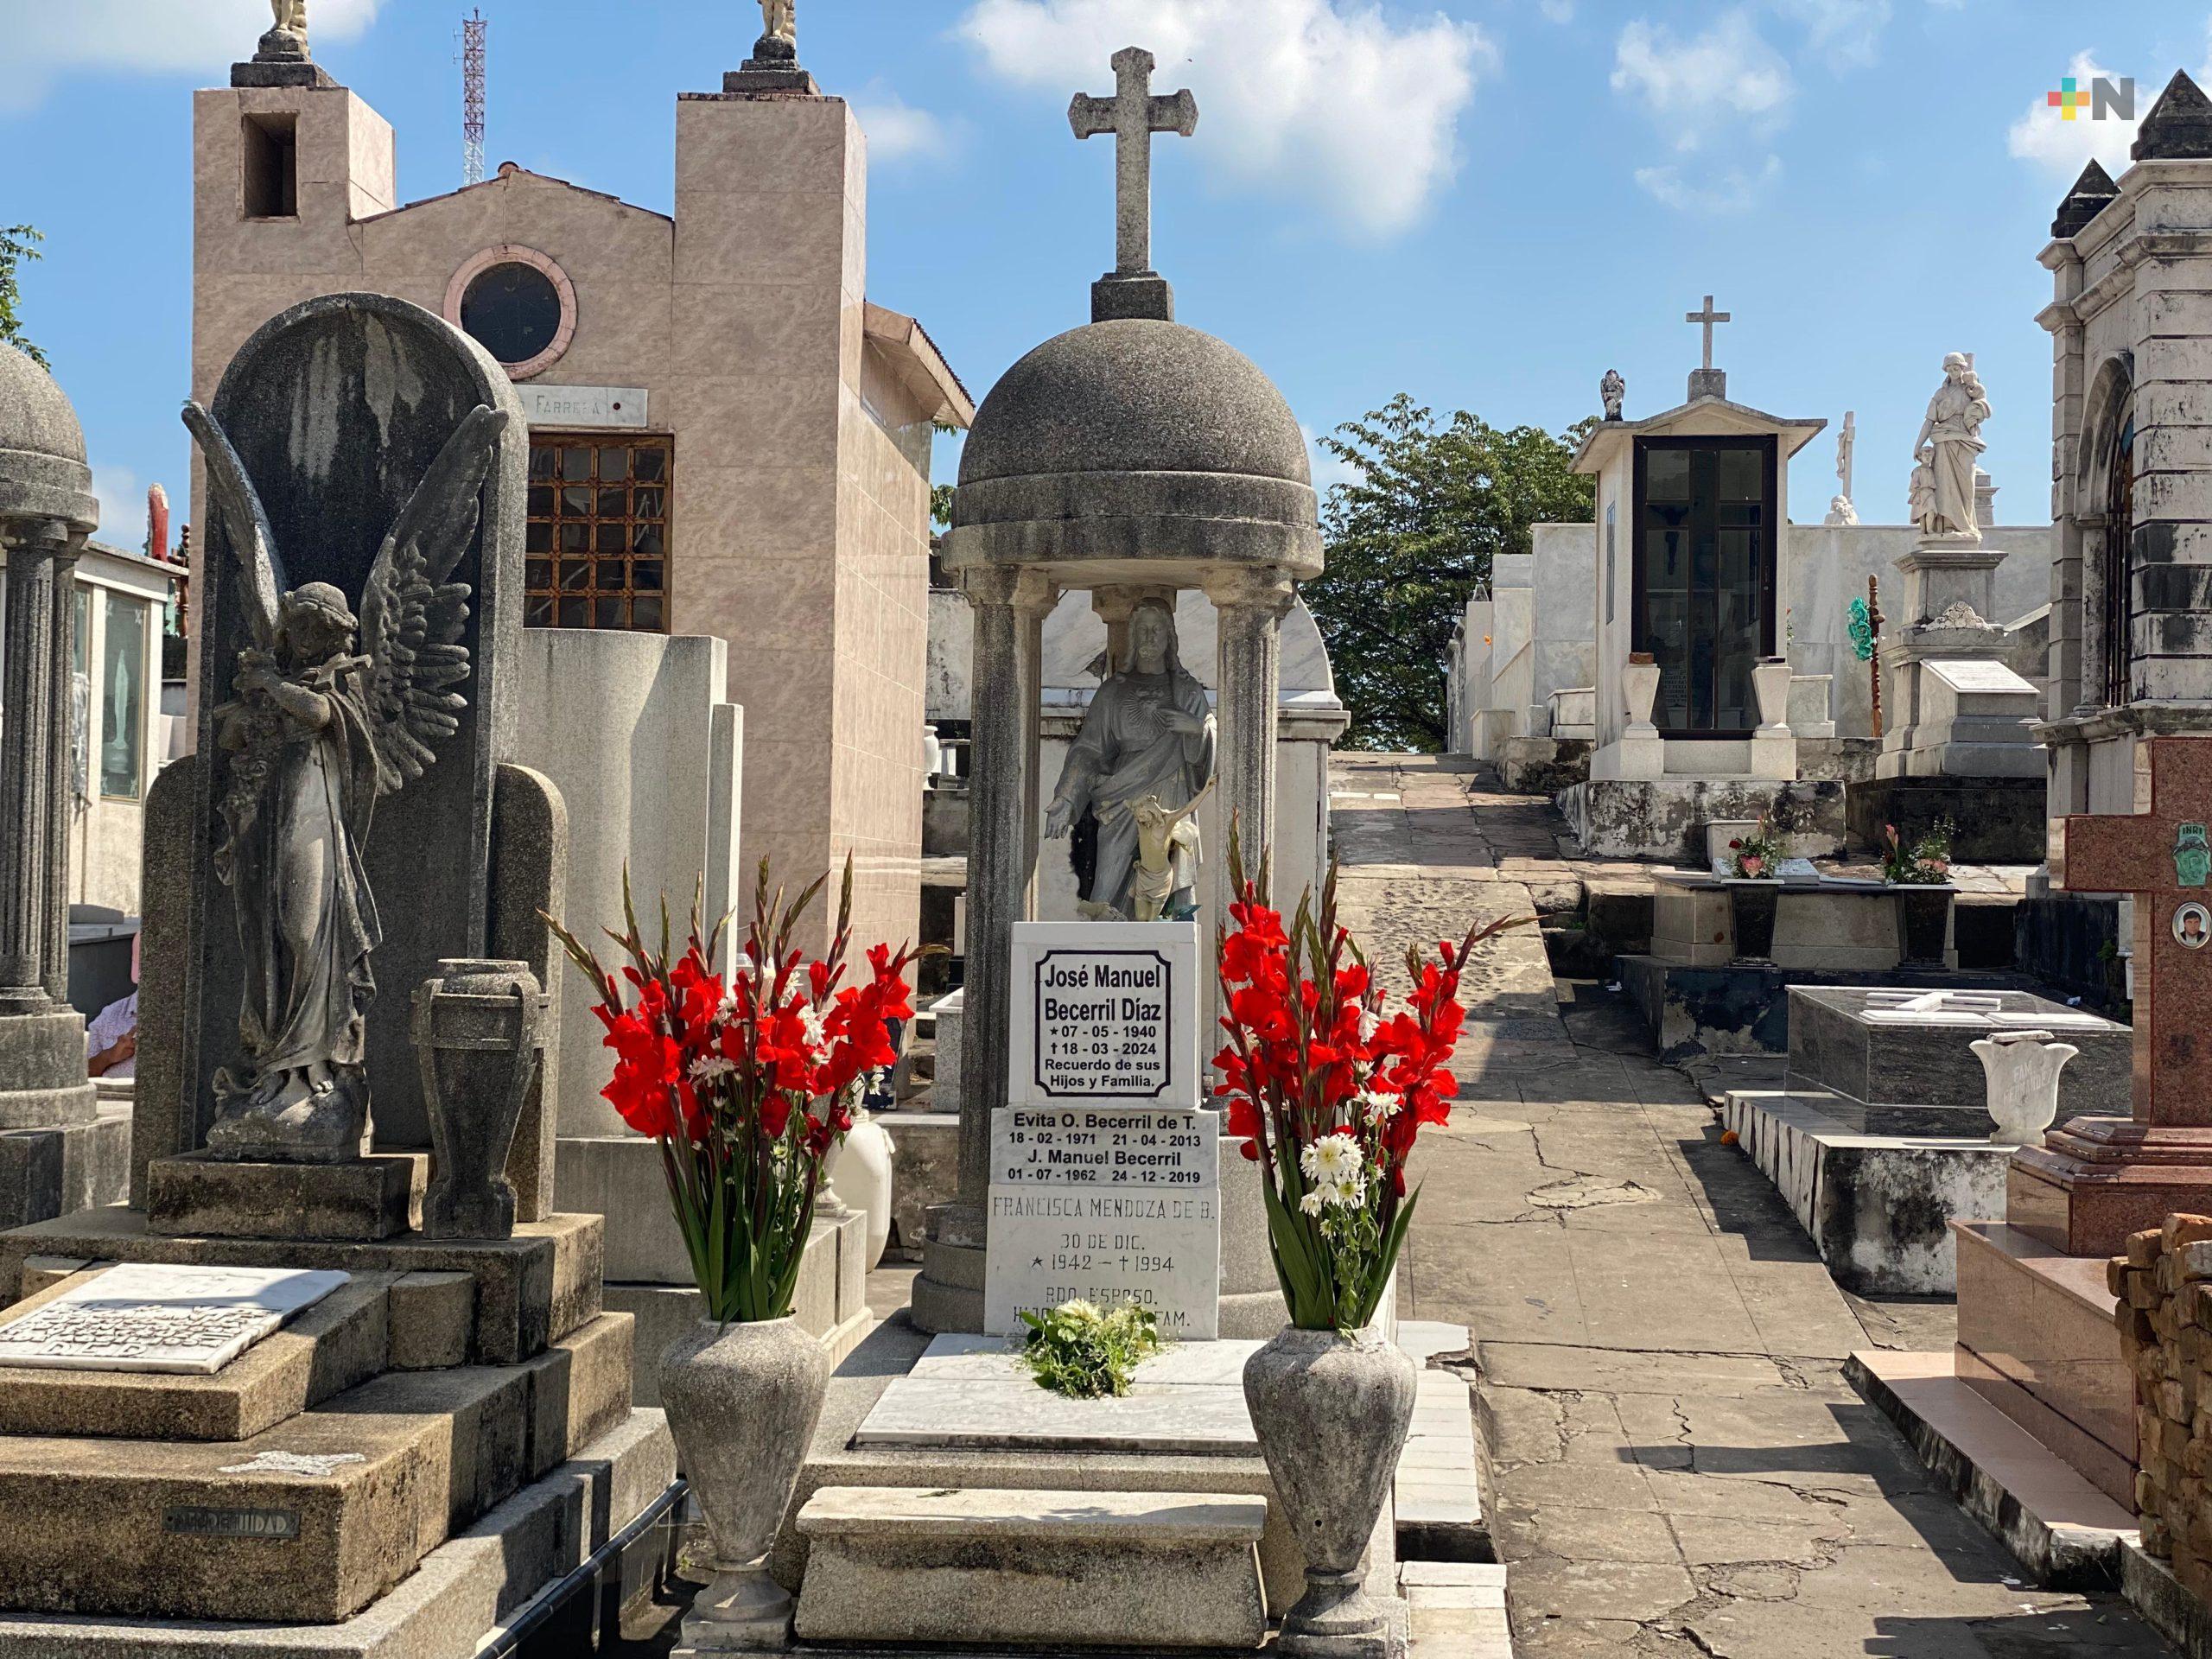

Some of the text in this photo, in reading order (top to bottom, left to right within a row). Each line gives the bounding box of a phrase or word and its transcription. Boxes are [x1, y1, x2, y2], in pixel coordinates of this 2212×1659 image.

[2183, 826, 2202, 835] INRI
[1044, 964, 1160, 988] José Manuel
[1045, 997, 1162, 1022] Becerril Díaz
[1061, 1025, 1078, 1038] 07
[1091, 1025, 1109, 1038] 05
[1122, 1025, 1157, 1039] 1940
[1061, 1042, 1078, 1055] 18
[1091, 1042, 1109, 1055] 03
[1122, 1042, 1157, 1055] 2024
[1045, 1058, 1160, 1071] Recuerdo de sus
[1050, 1075, 1155, 1090] Hijos y Familia.
[1014, 1112, 1197, 1131] Evita O. Becerril de T.
[1008, 1132, 1025, 1144] 18
[1036, 1132, 1053, 1145] 02
[1065, 1133, 1096, 1145] 1971
[1112, 1134, 1127, 1146] 21
[1141, 1135, 1157, 1147] 04
[1169, 1135, 1201, 1147] 2013
[1027, 1149, 1181, 1166] J. Manuel Becerril
[1007, 1168, 1022, 1180] 01
[1036, 1168, 1052, 1180] 07
[1065, 1169, 1096, 1181] 1962
[1111, 1170, 1128, 1182] 24
[1141, 1171, 1157, 1183] 12
[1168, 1172, 1201, 1184] 2019
[993, 1196, 1215, 1219] FRANCISCA MENDOZA DE B.
[1060, 1233, 1146, 1251] 30 DE DIC.
[1052, 1254, 1092, 1270] 1942
[1135, 1255, 1175, 1273] 1994
[1090, 1287, 1158, 1306] ESPOSO.
[1154, 1311, 1191, 1327] FAM.
